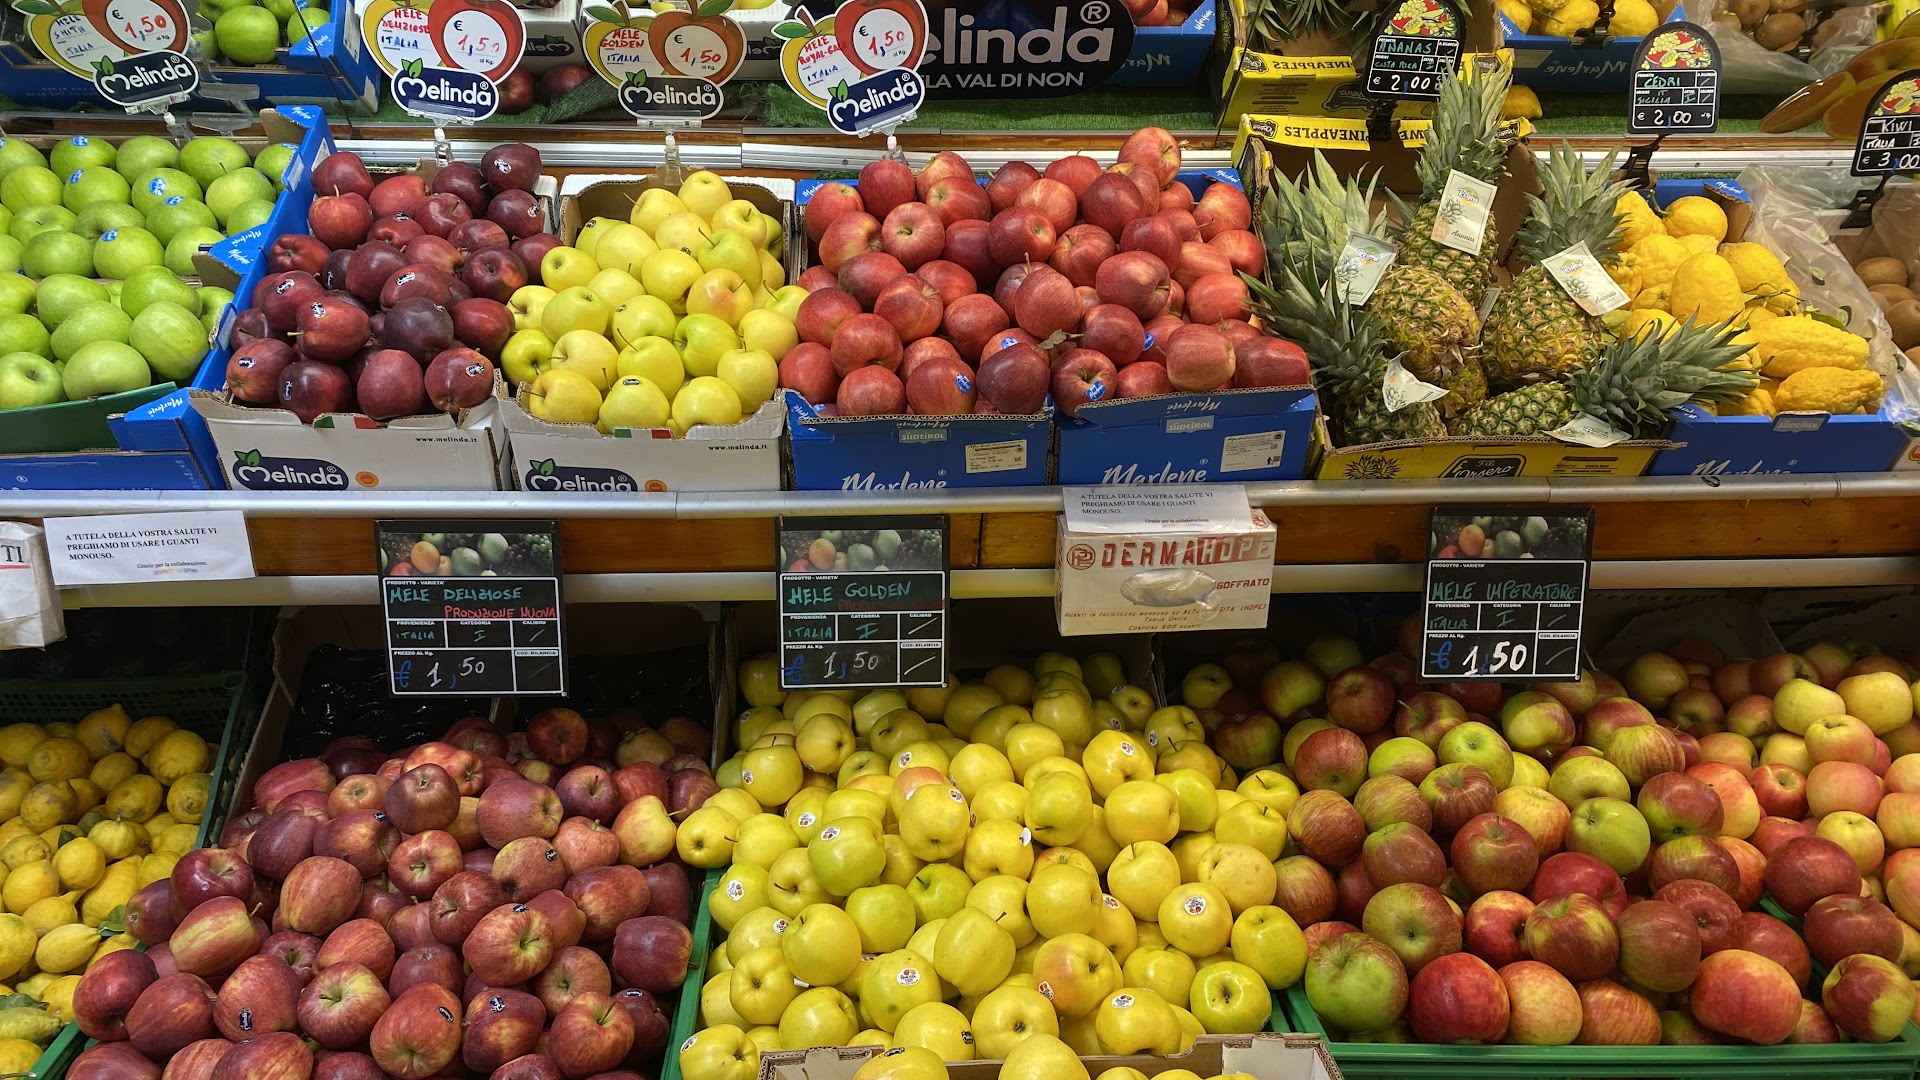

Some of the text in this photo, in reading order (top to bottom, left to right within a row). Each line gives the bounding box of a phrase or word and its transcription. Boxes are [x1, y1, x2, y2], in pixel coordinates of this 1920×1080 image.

[112, 9, 124, 20] €
[125, 15, 167, 41] 1,50
[454, 20, 463, 31] €
[859, 26, 869, 37] €
[54, 26, 86, 40] SMITH
[612, 29, 640, 40] MELE
[673, 34, 684, 44] €
[381, 36, 419, 49] ITALIA
[600, 39, 645, 48] GOLDEN
[804, 35, 830, 53] MELE
[868, 30, 906, 57] 1,50
[1378, 41, 1433, 54] ANANAS
[607, 53, 640, 63] ITALIA
[680, 47, 722, 66] 1,50
[1399, 61, 1418, 70] RICA
[807, 65, 839, 82] ITALIA
[956, 72, 1084, 89] VAL DI NON
[1373, 76, 1381, 85] €
[1391, 74, 1431, 94] 2,00
[1644, 76, 1680, 88] CEDRI
[1637, 112, 1646, 121] €
[1653, 109, 1692, 128] 2,00
[1881, 118, 1912, 133] KIWI
[1284, 126, 1369, 142] INEAPPLES
[1862, 156, 1870, 164] €
[1878, 152, 1920, 174] 3,00
[708, 443, 768, 451] www.melinda.it
[72, 533, 108, 541] TUTELA
[108, 531, 137, 539] DELLA
[138, 529, 173, 537] VOSTRA
[174, 528, 206, 536] SALUTE
[67, 542, 119, 551] PREGHIAMO
[131, 540, 160, 548] USARE
[166, 538, 199, 546] GUANTI
[1, 545, 24, 563] TI
[69, 552, 115, 561] MONOUSO.
[1216, 578, 1270, 590] GOFFRATO
[390, 587, 523, 604] MELE DELIZIOSE
[788, 586, 833, 606] MELE
[844, 581, 911, 599] GOLDEN
[1432, 580, 1580, 602] MELE IMPERATORE
[444, 605, 556, 619] PRODUZIONE NUOVA
[1496, 610, 1515, 627] I
[1430, 616, 1469, 630] ITALIA
[396, 631, 435, 640] ITALIA
[474, 629, 486, 642] I
[788, 627, 833, 640] ITALIA
[1462, 640, 1527, 676] 1,50
[824, 651, 879, 679] 1,50
[394, 656, 485, 689] € 1,50
